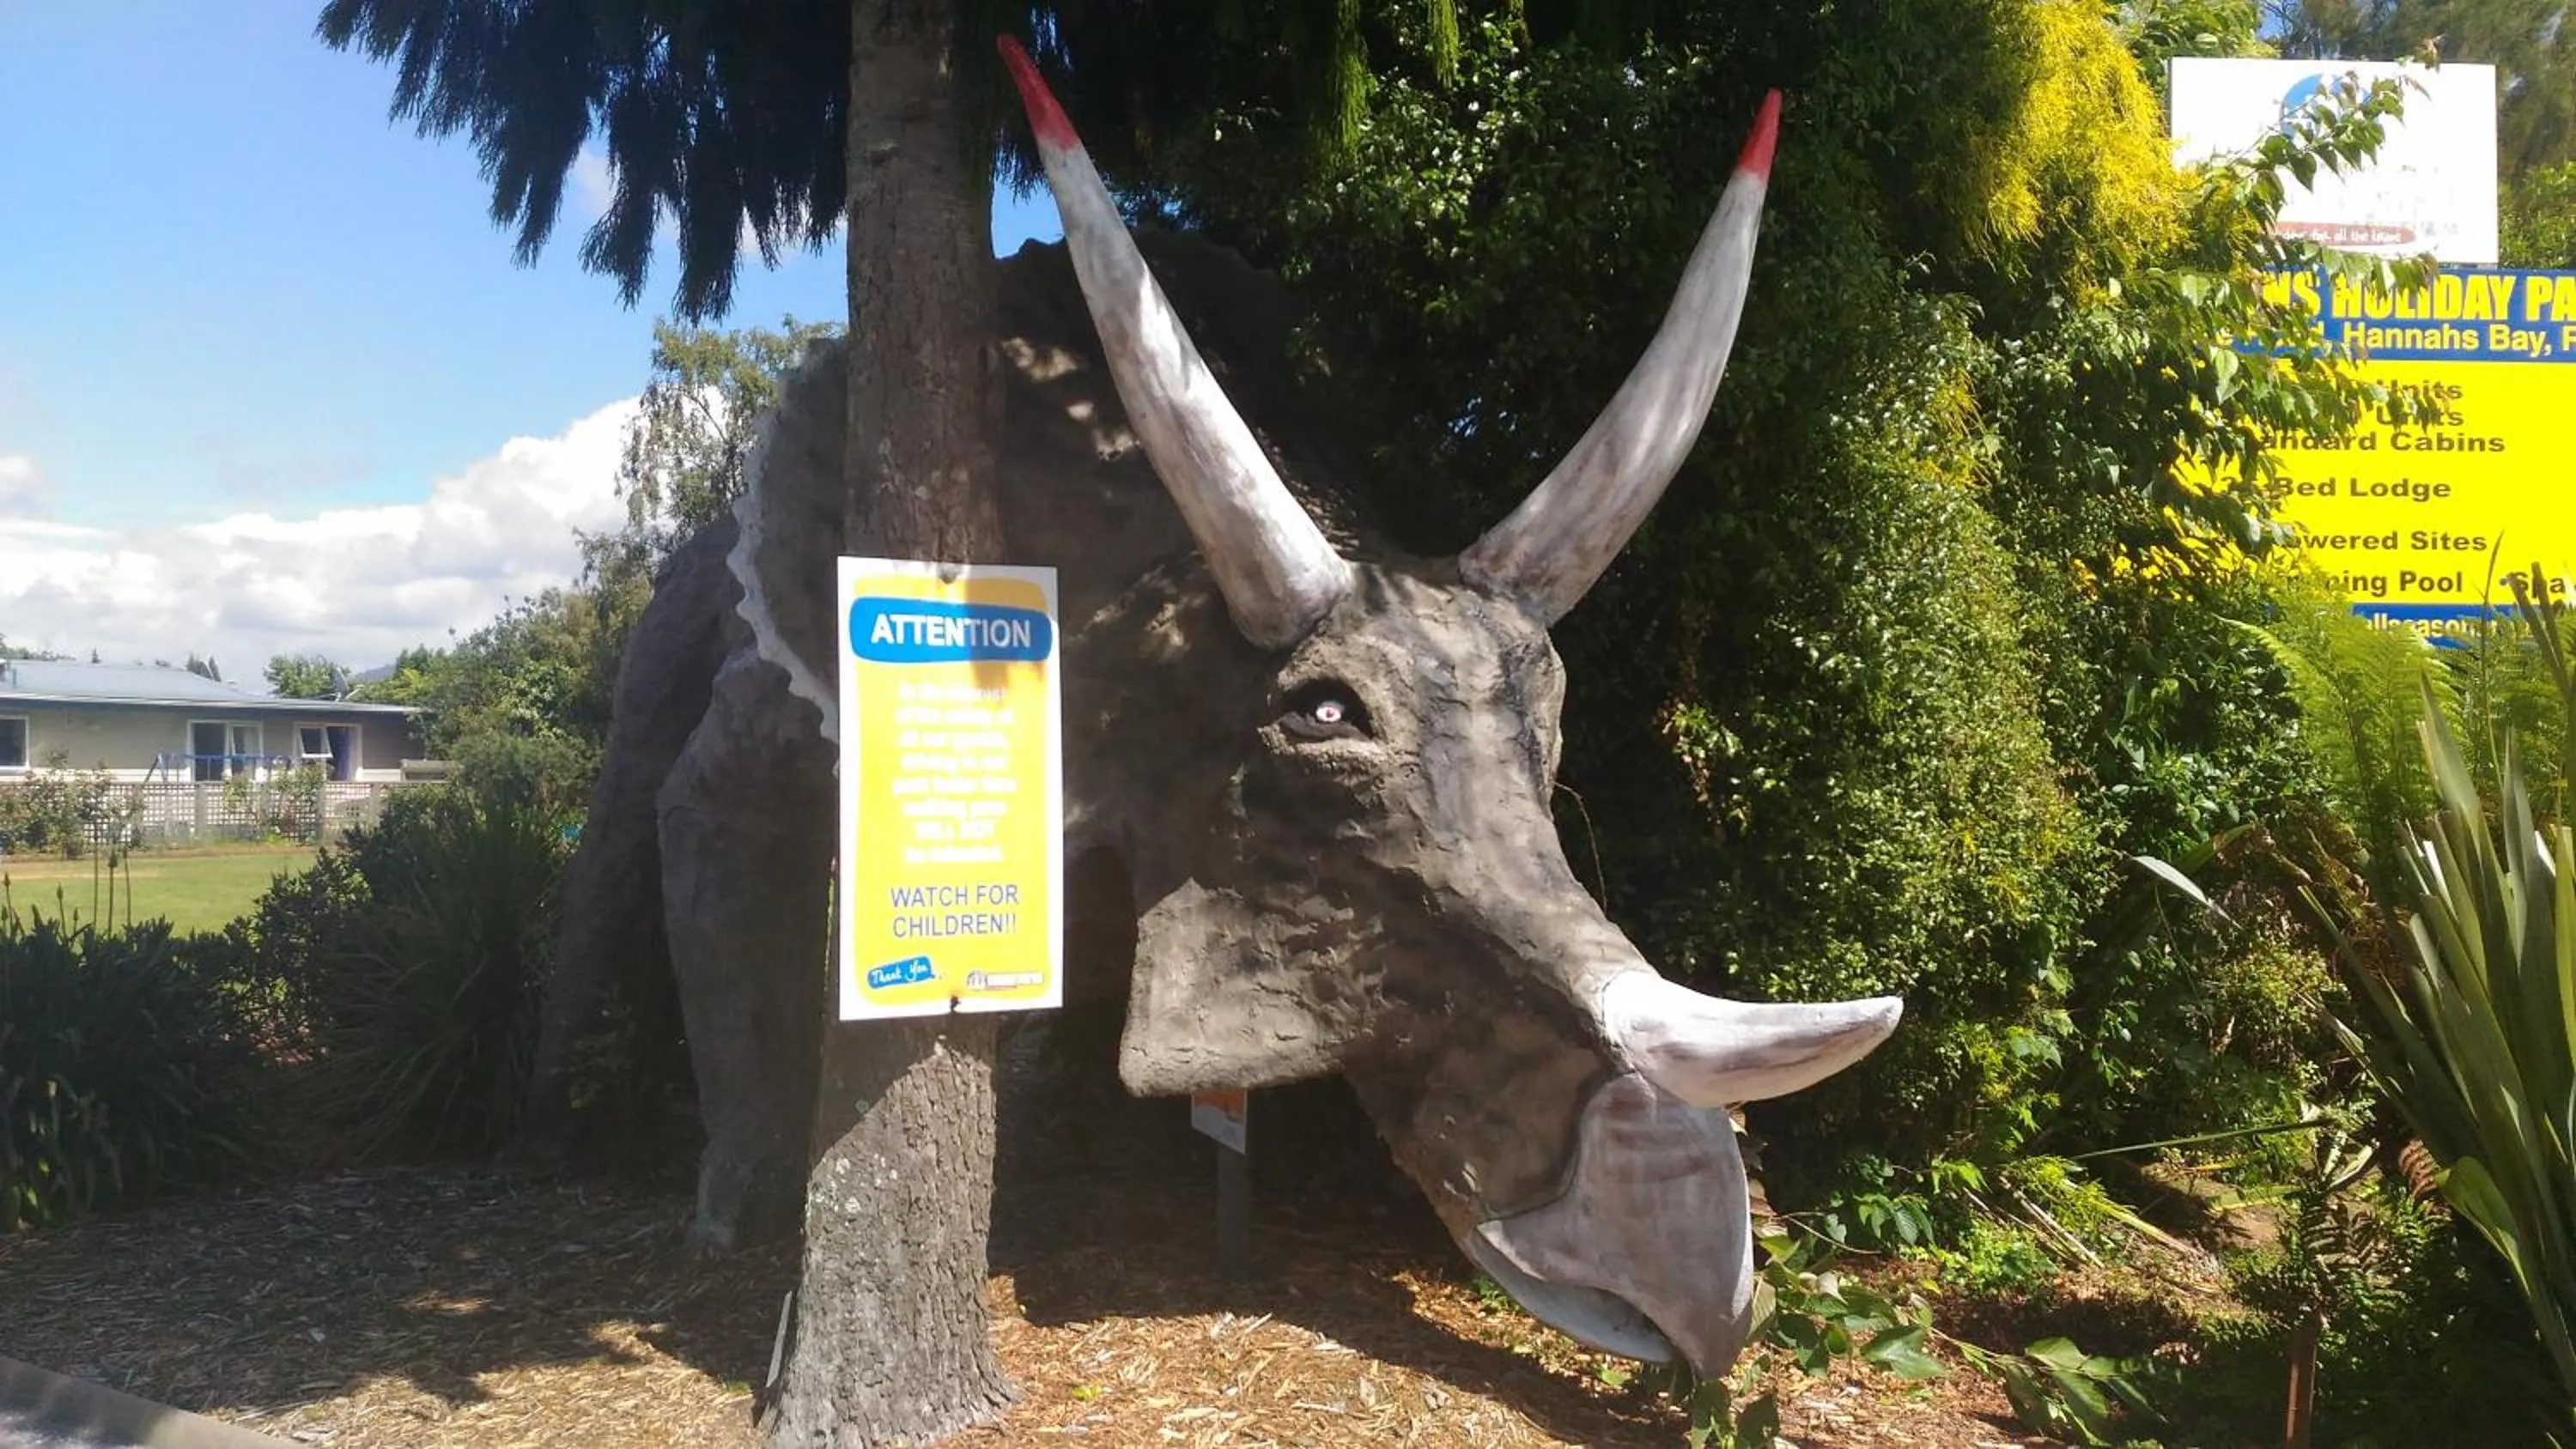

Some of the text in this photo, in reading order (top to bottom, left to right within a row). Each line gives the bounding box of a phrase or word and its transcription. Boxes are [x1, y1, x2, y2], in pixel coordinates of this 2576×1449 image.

[2330, 273, 2517, 319] HOLIDAY
[2343, 321, 2479, 351] Hannahs
[2489, 324, 2552, 357] Bay,
[2376, 404, 2464, 427] Unts
[2390, 432, 2505, 452] Cabins
[2275, 477, 2451, 502] Bed Lodge
[2410, 530, 2488, 550] Sites
[2400, 570, 2463, 592] Pool
[871, 613, 1031, 648] ATTENTION
[890, 883, 1018, 907] WATCH FOR
[893, 913, 1017, 938] CHILDREN!!
